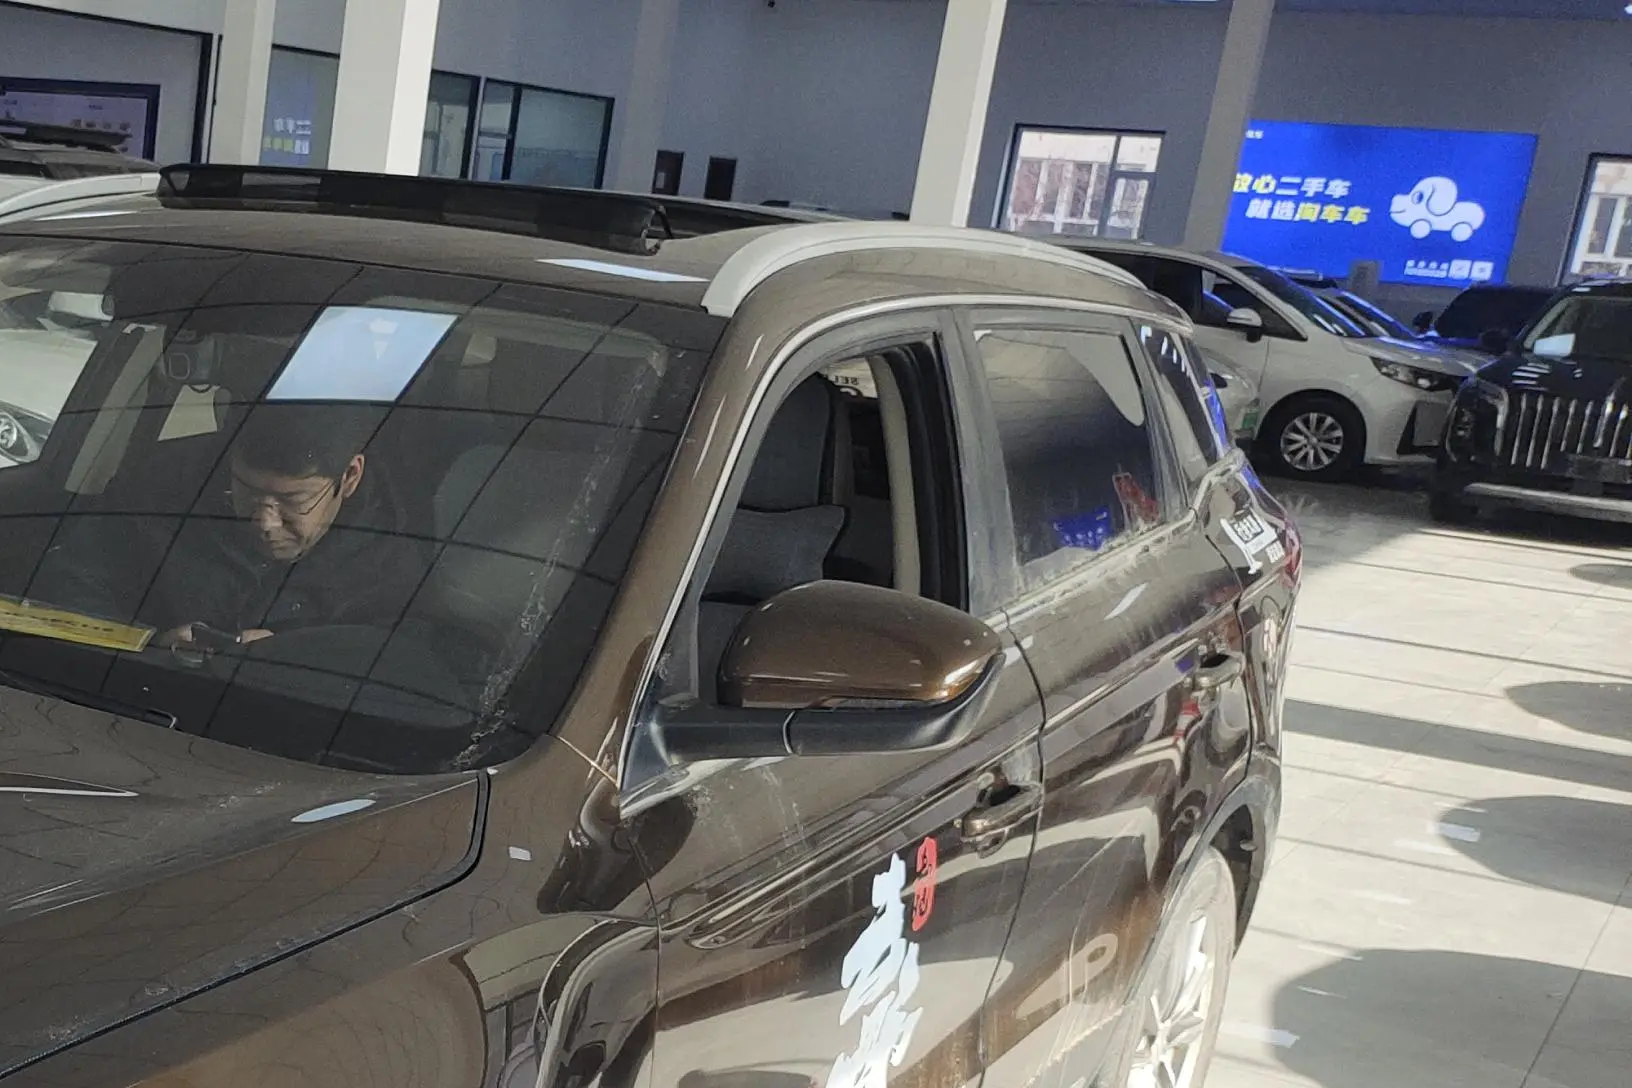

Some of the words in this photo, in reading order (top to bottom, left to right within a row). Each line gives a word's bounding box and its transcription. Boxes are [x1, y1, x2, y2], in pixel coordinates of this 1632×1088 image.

[1245, 198, 1370, 225] 就选淘车车
